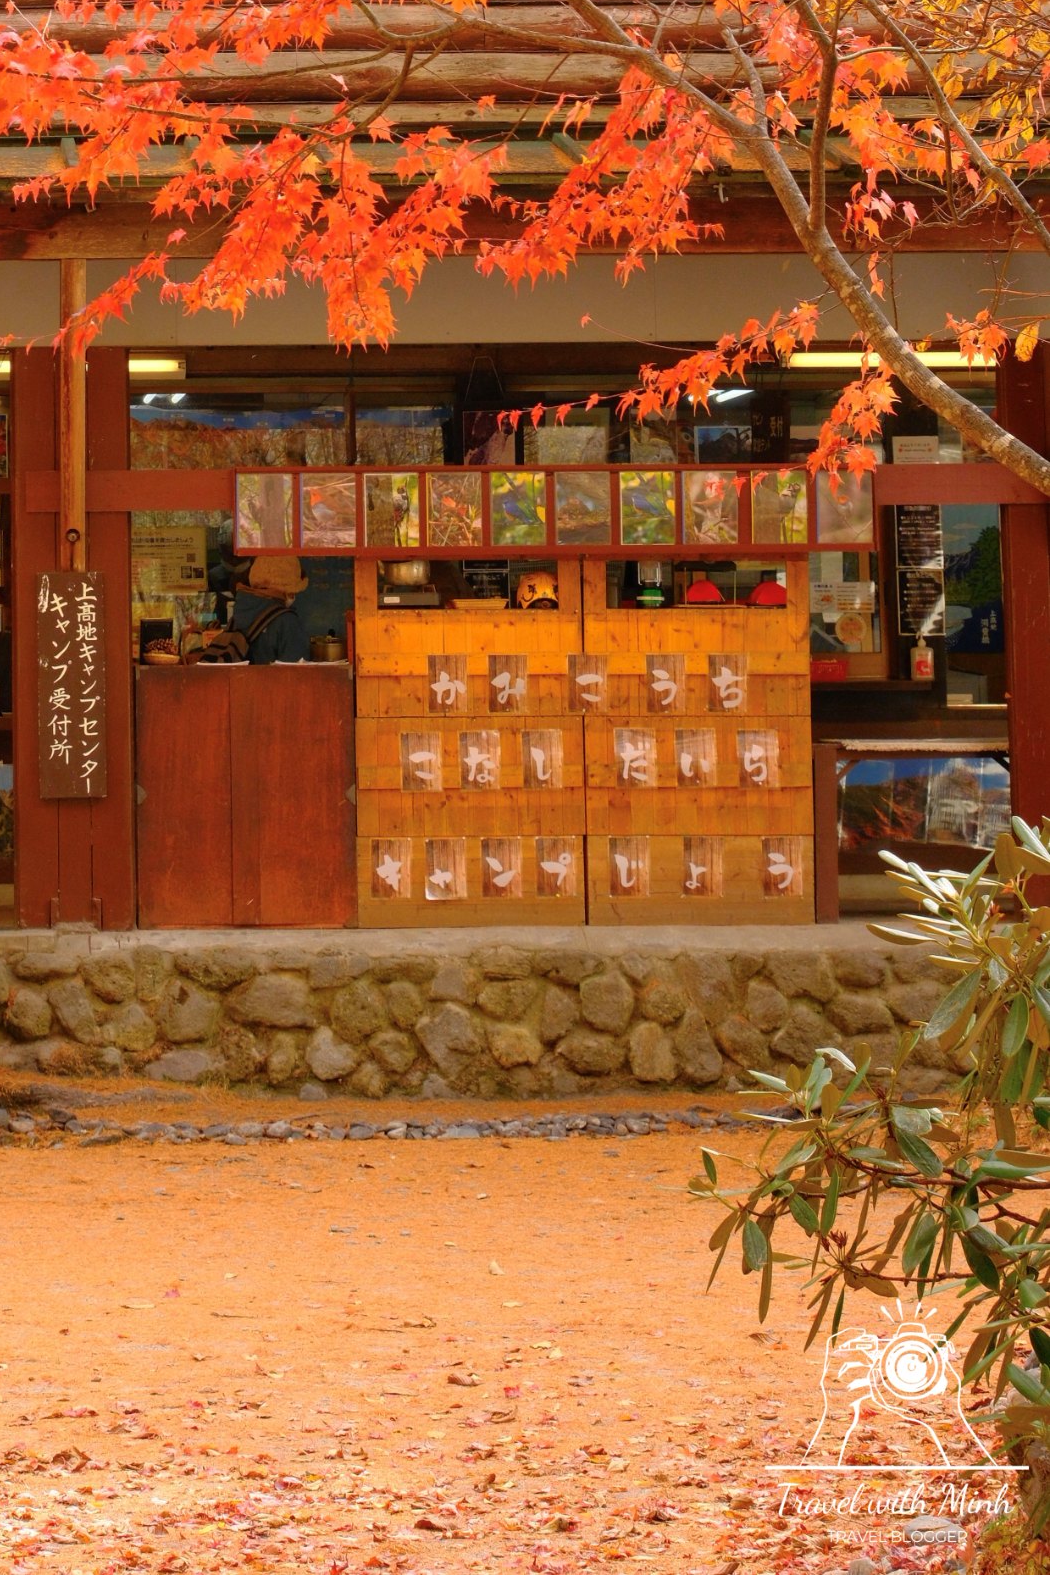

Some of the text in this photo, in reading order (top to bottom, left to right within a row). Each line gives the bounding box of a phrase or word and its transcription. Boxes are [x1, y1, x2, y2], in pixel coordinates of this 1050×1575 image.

[47, 592, 74, 765] キャンプ受付所
[430, 666, 748, 708] かみこうち
[375, 852, 795, 891] キャンプじょう
